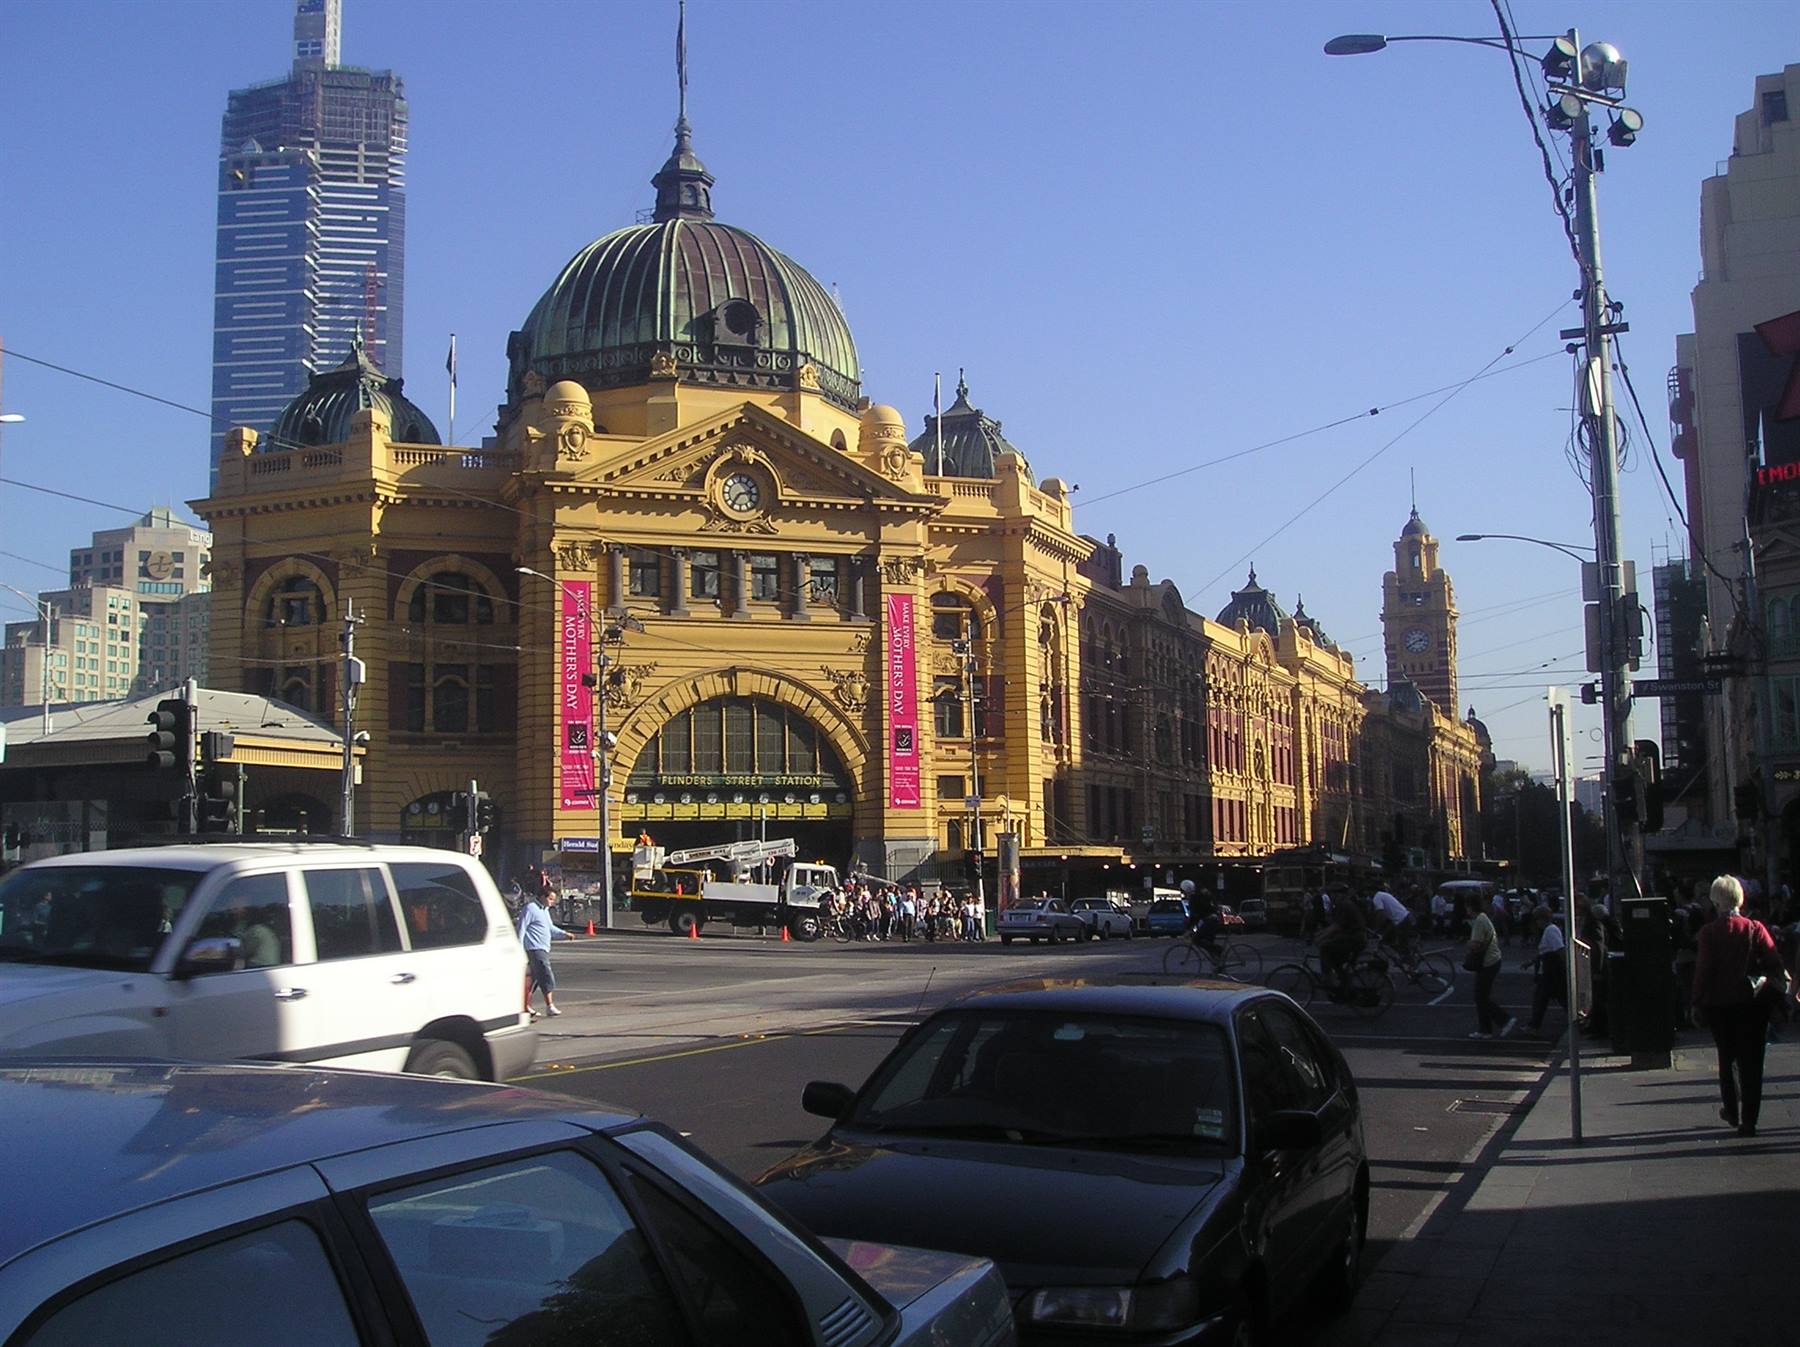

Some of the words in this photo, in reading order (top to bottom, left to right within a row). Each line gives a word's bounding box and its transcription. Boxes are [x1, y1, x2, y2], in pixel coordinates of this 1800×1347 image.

[902, 602, 910, 624] MAKE
[565, 616, 578, 680] MOTHER'S
[893, 626, 904, 687] MOTHER'S
[566, 684, 578, 710] DAY
[1649, 682, 1704, 691] Swanston
[1707, 680, 1721, 690] St
[893, 690, 904, 715] DAY
[661, 775, 712, 785] FLINDERS
[725, 775, 764, 785] STREET
[775, 775, 821, 785] STATION
[563, 840, 585, 848] Herald
